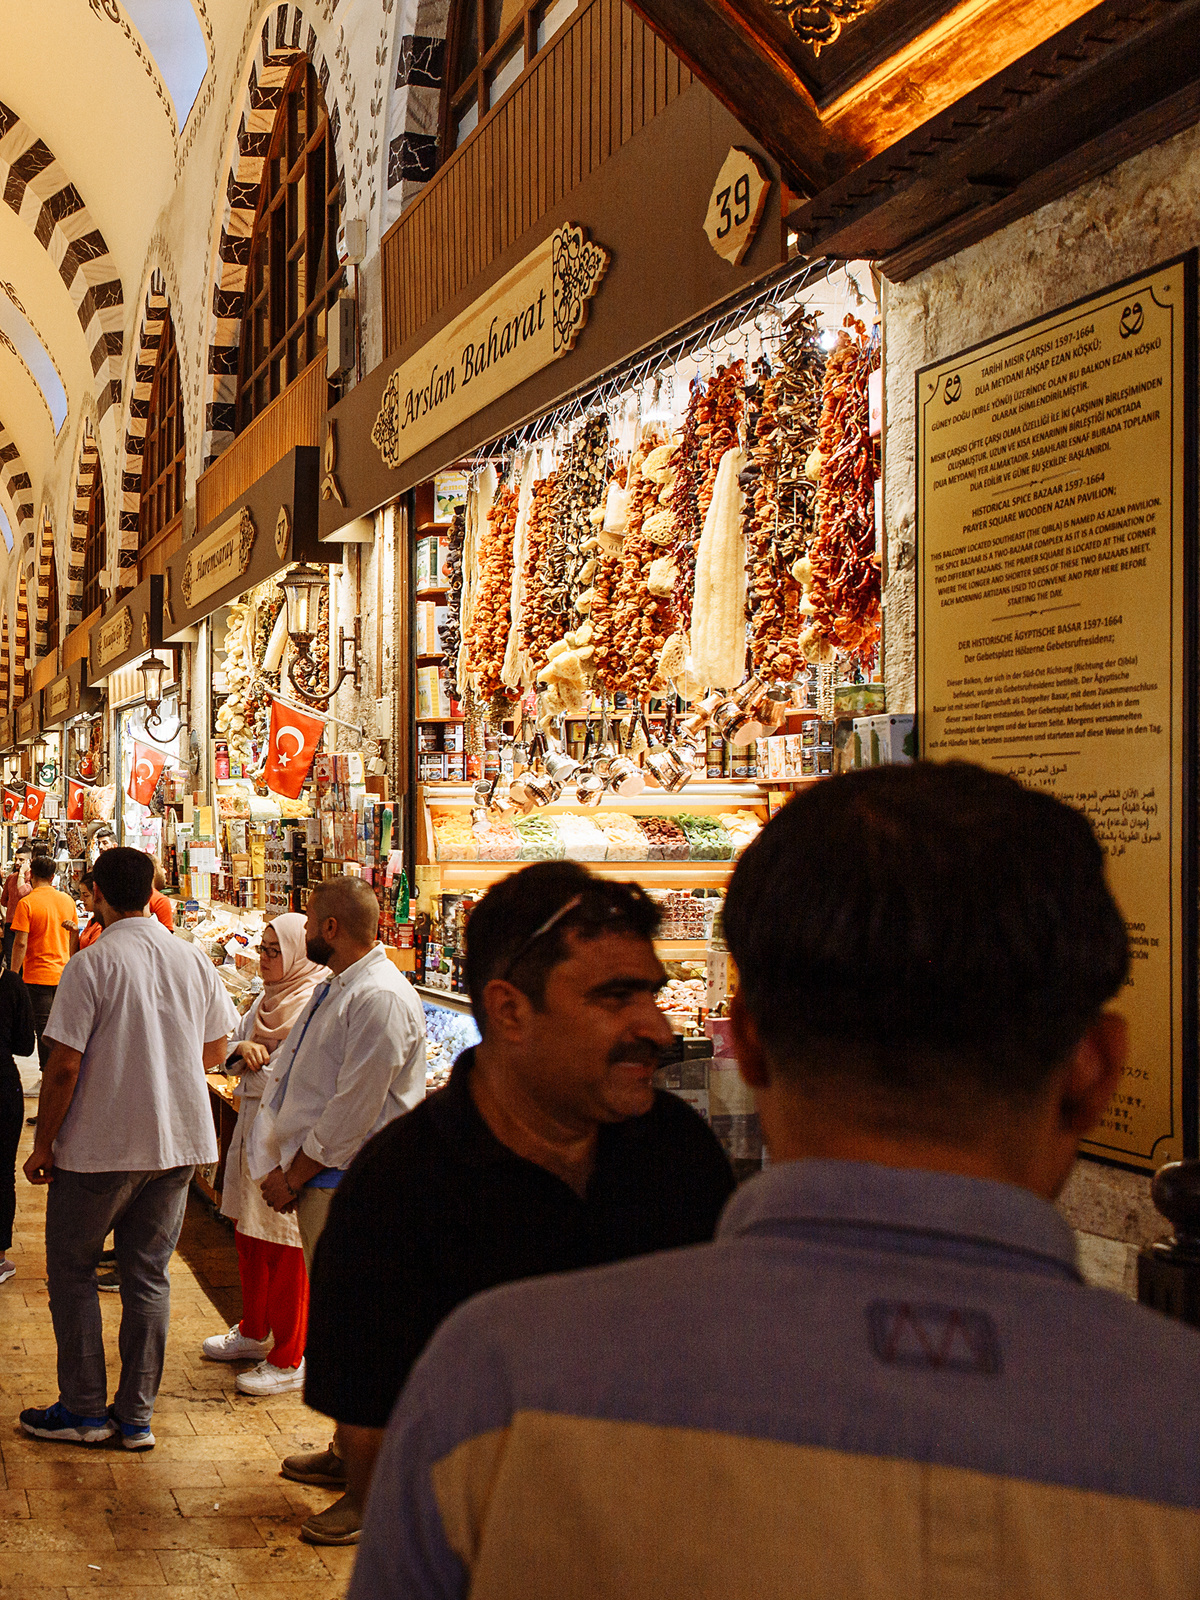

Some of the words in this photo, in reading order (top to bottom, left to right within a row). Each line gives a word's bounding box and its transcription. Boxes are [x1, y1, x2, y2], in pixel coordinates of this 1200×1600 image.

[715, 172, 751, 240] 39
[400, 365, 457, 430] Arslan
[460, 287, 548, 389] Baharat
[1005, 353, 1024, 368] MISIR
[1055, 324, 1094, 348] 1597-1664
[975, 383, 989, 396] DUA
[991, 370, 1023, 390] MEYDANI
[1051, 351, 1071, 367] EZAN
[1048, 374, 1067, 388] OLAN
[1081, 358, 1110, 376] BALKON
[1112, 350, 1132, 365] EZAN
[989, 446, 1006, 457] UZUN
[1017, 437, 1030, 448] KISA
[1032, 425, 1067, 443] KENARININ
[1106, 400, 1141, 419] NOKTADA
[992, 407, 1017, 422] OLARAK
[931, 452, 946, 463] MISIR
[1003, 426, 1021, 439] OLMA
[933, 479, 947, 491] (DUA
[948, 469, 976, 484] MEYDANI)
[978, 465, 988, 475] YER
[1032, 440, 1067, 459] SABAHLARI
[1069, 432, 1089, 446] ESNAF
[1092, 423, 1121, 439] BURADA
[1123, 410, 1160, 429] TOPLANIR
[437, 484, 468, 492] Lemo
[970, 481, 982, 492] DUA
[1012, 493, 1031, 506] SPICE
[1033, 484, 1063, 500] BAZAAR
[1065, 472, 1105, 492] 1597-1664
[277, 518, 286, 545] 37
[931, 552, 942, 561] THIS
[943, 547, 966, 558] BALCONY
[968, 540, 991, 552] LOCATED
[992, 531, 1025, 546] SOUTHEAST
[1027, 528, 1040, 539] (THE
[1042, 522, 1062, 534] QIBLA)
[1071, 514, 1095, 527] NAMED
[1107, 506, 1125, 518] AZAN
[963, 520, 987, 534] PRAYER
[989, 512, 1016, 527] SQUARE
[1018, 503, 1052, 519] WOODEN
[1054, 497, 1075, 510] AZAN
[195, 538, 234, 582] Haremsaray
[935, 564, 944, 572] THE
[945, 560, 959, 570] SPICE
[960, 555, 981, 566] BAZAAR
[1034, 536, 1063, 549] COMPLEX
[935, 575, 947, 584] TWO
[948, 569, 975, 581] DIFFERENT
[1004, 560, 1014, 568] THE
[1016, 555, 1038, 566] PRAYER
[1040, 548, 1064, 561] SQUARE
[1073, 540, 1101, 553] LOCATED
[1113, 534, 1125, 544] THE
[1127, 527, 1156, 541] CORNER
[938, 586, 956, 595] WHERE
[958, 583, 967, 591] THE
[968, 578, 990, 589] LONGER
[991, 575, 1004, 584] AND
[1005, 569, 1031, 581] SHORTER
[1033, 565, 1049, 576] SIDES
[1060, 559, 1078, 569] THESE
[1081, 555, 1096, 565] TWO
[1098, 548, 1128, 561] BAZAARS
[941, 598, 954, 607] EACH
[955, 592, 982, 604] MORNING
[983, 587, 1010, 598] ARTIZANS
[1011, 583, 1027, 593] USED
[1037, 574, 1066, 587] CONVENE
[1068, 572, 1082, 581] AND
[1084, 568, 1100, 578] PRAY
[1102, 564, 1118, 574] HERE
[1120, 557, 1146, 571] BEFORE
[1008, 594, 1035, 606] STARTING
[1037, 592, 1048, 600] THE
